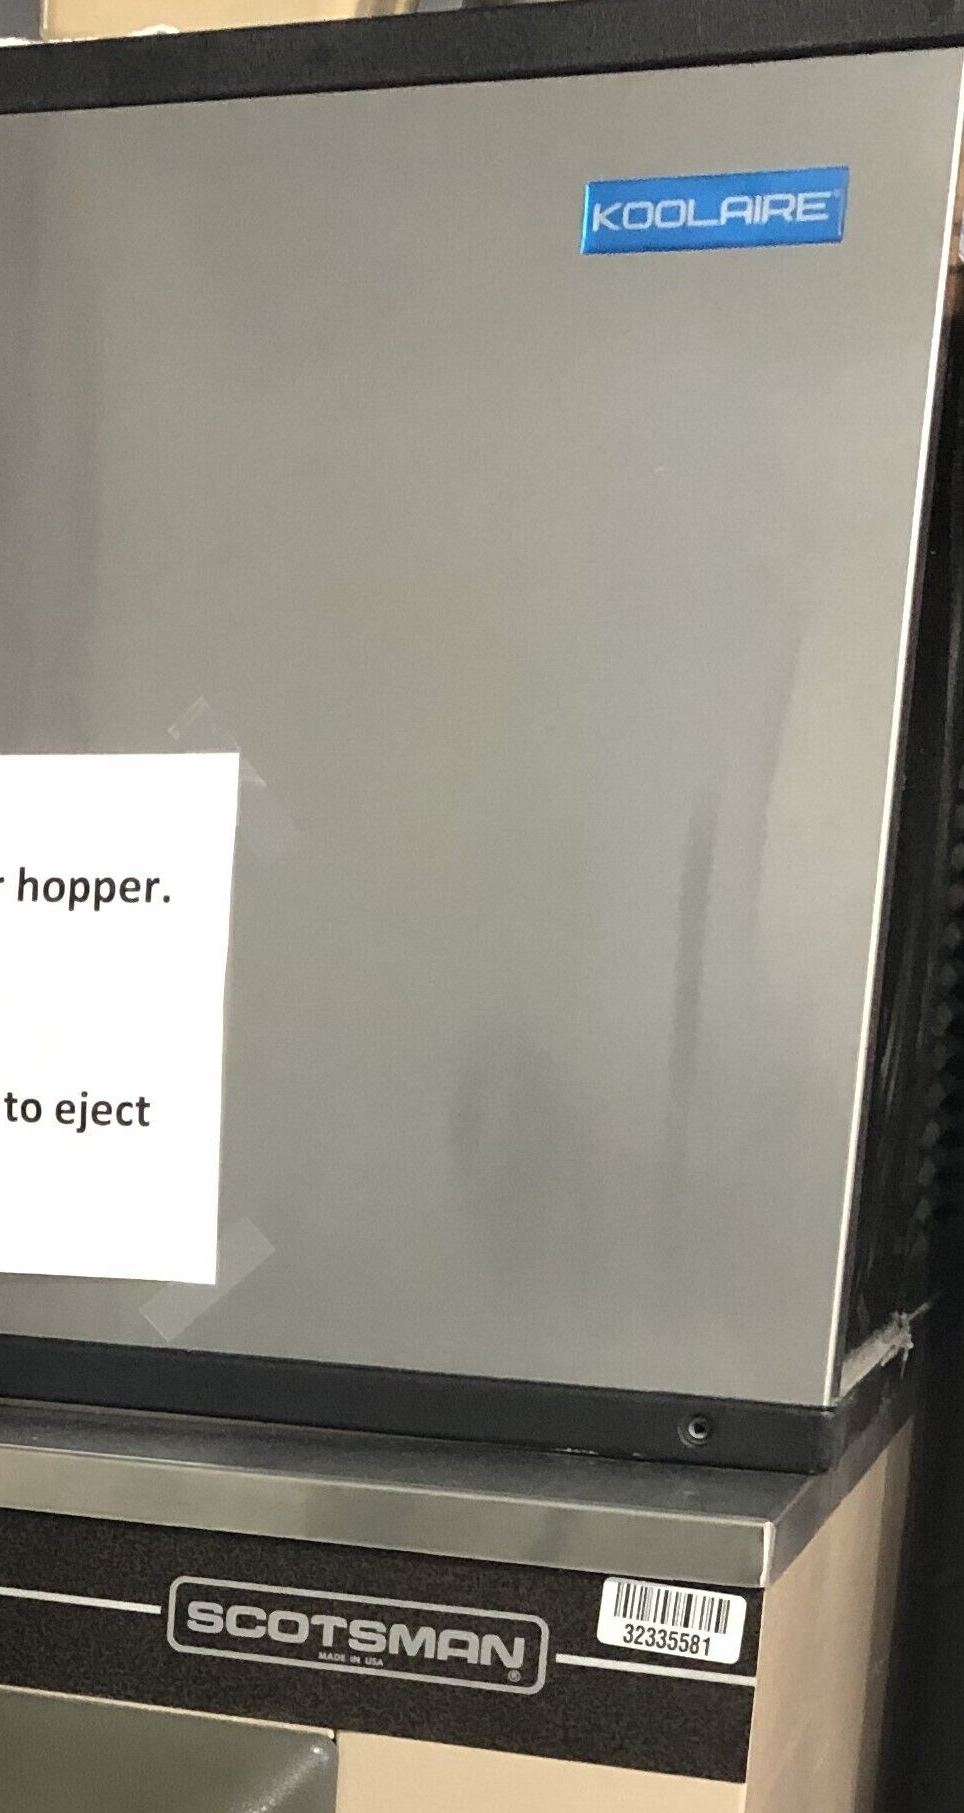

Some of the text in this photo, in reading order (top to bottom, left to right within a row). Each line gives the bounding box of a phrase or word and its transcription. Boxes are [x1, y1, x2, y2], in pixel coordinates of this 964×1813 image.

[592, 191, 832, 232] KOOLAIRE
[17, 867, 172, 911] hopper.
[4, 1092, 42, 1124] to
[54, 1091, 151, 1134] eject
[186, 1600, 525, 1670] SCOTSMAN
[623, 1623, 711, 1656] 32335581
[318, 1652, 384, 1667] MADE IN USA
